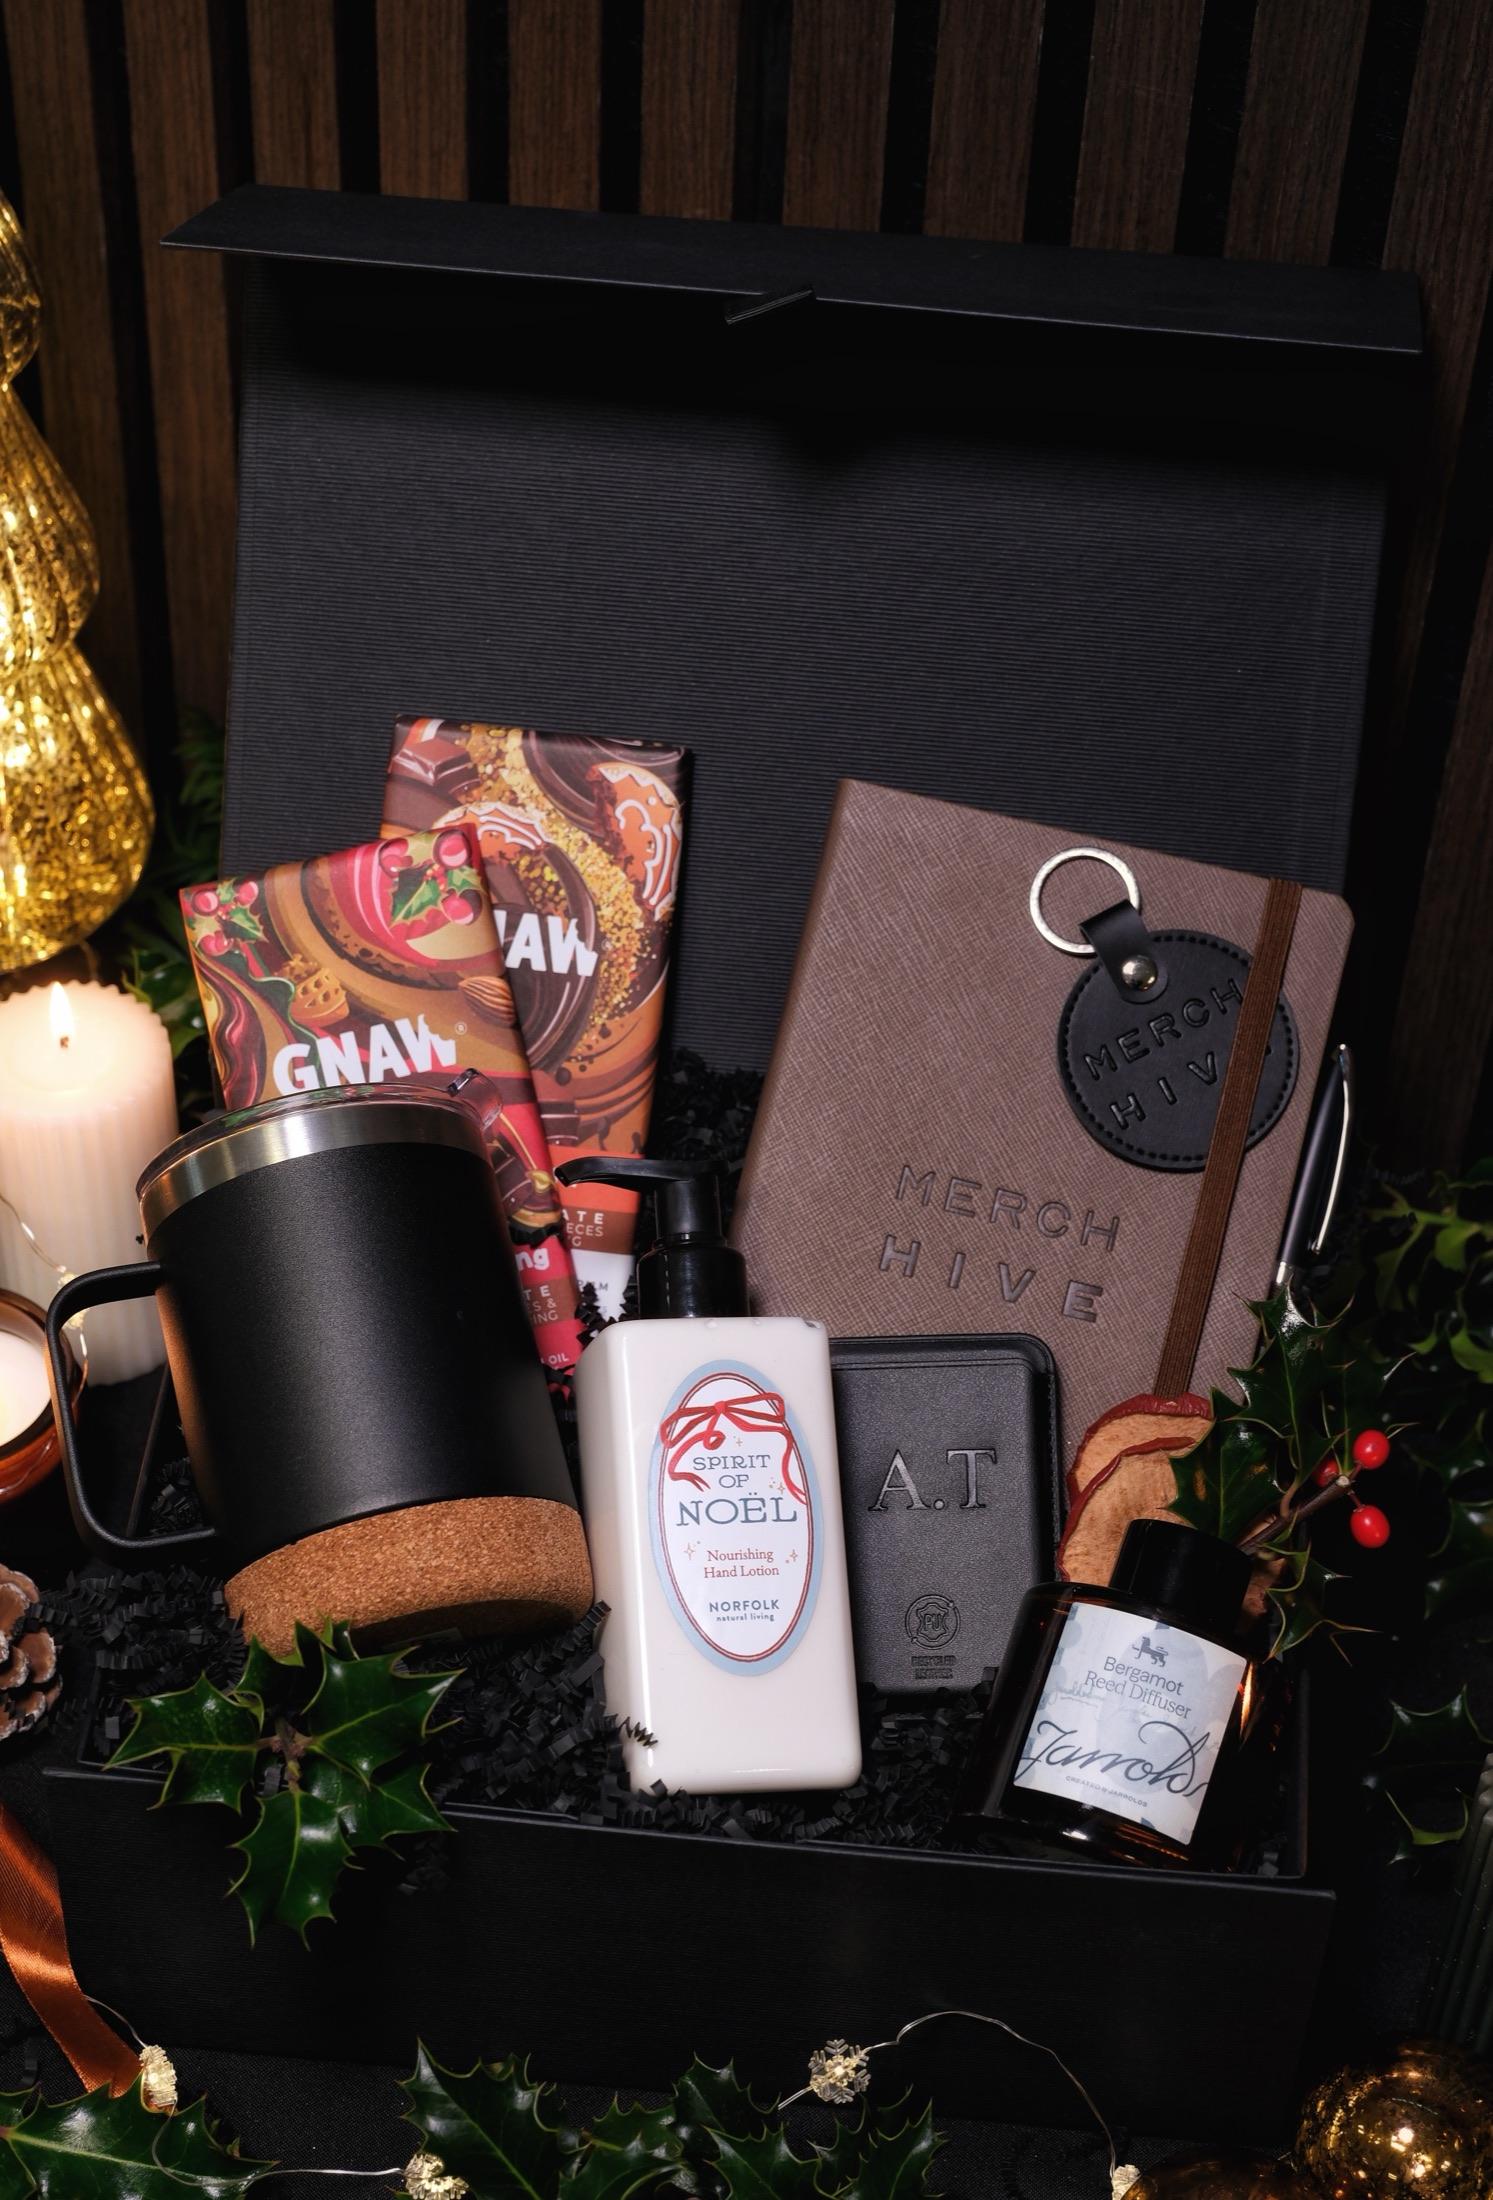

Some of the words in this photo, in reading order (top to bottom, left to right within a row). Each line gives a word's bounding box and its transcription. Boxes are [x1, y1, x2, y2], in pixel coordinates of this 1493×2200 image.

[1083, 977, 1244, 1081] MERCH
[272, 1013, 457, 1097] GNAW
[1109, 1046, 1272, 1131] HIV
[896, 1164, 1120, 1251] MERCH
[879, 1234, 1104, 1323] HIVE
[548, 1352, 569, 1365] OIL
[692, 1454, 771, 1471] SPIRIT
[718, 1474, 750, 1489] OF
[868, 1448, 998, 1511] A.T
[676, 1492, 798, 1527] NOËL
[704, 1566, 738, 1579] Hand
[740, 1565, 780, 1577] Lotion
[707, 1548, 774, 1563] Nourishing
[709, 1599, 780, 1613] NORFOLK
[715, 1613, 748, 1622] natural
[750, 1612, 775, 1622] living
[1103, 1655, 1185, 1696] Bergamot
[1084, 1670, 1126, 1696] Reed
[1129, 1683, 1192, 1720] Diffuser
